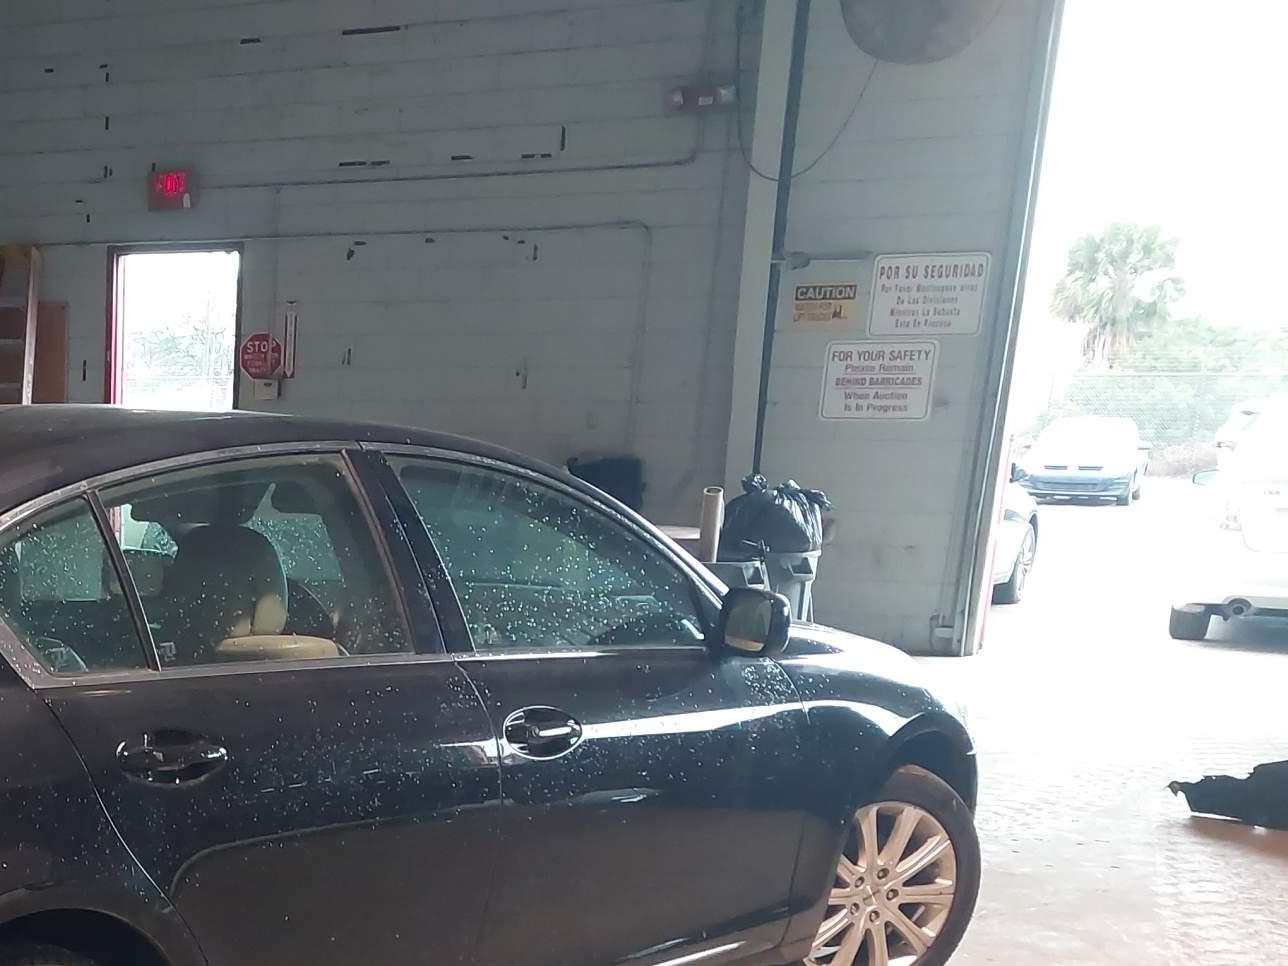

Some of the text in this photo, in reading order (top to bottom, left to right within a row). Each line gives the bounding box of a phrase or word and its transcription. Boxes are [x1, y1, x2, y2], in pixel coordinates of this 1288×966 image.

[879, 263, 984, 280] POR SU SEGURIDAD
[797, 286, 855, 299] CAUTION
[832, 349, 931, 361] FOR YOUR SAFETY
[835, 376, 922, 386] BEHIND BARRICADES
[844, 391, 908, 400] When Auction
[844, 402, 908, 413] Is In Progress
